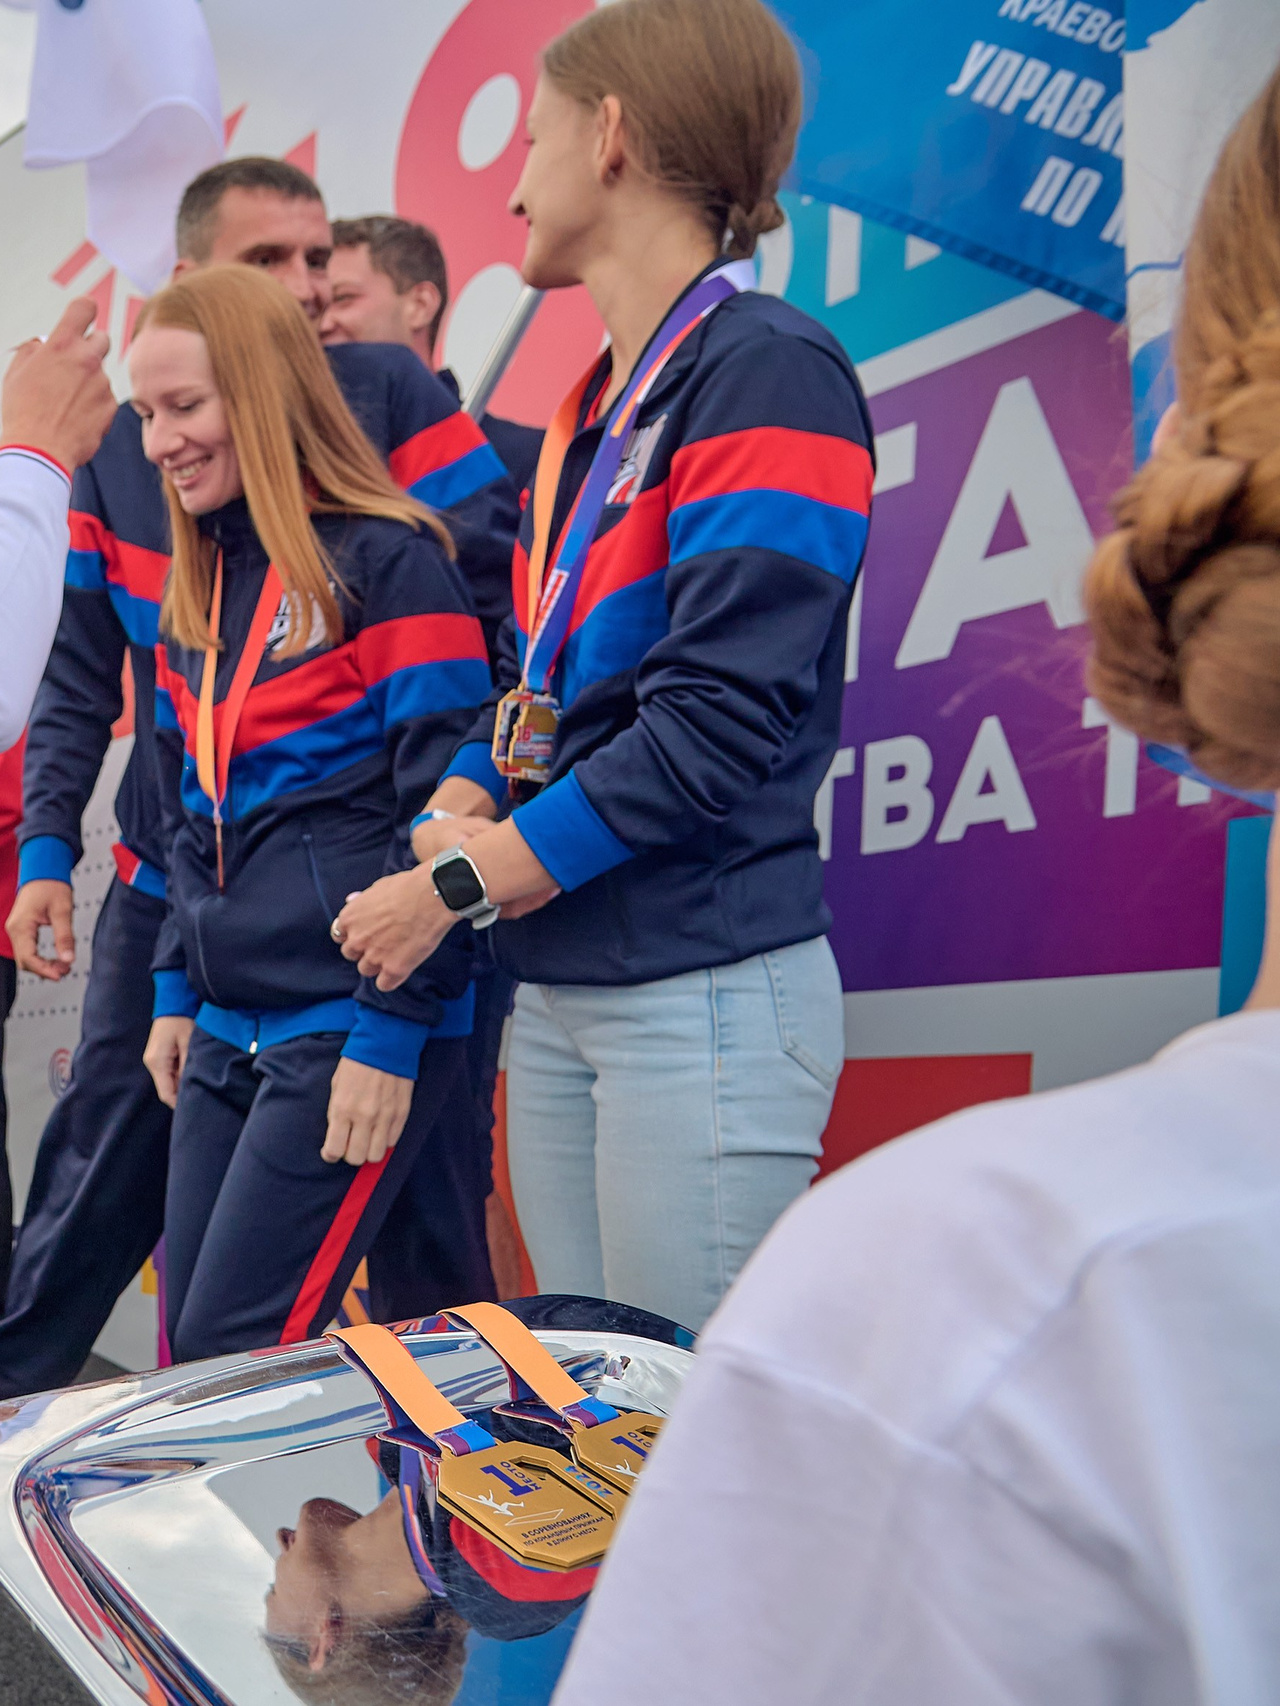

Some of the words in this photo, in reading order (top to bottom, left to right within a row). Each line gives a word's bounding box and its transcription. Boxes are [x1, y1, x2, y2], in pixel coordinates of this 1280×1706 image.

[998, 0, 1126, 57] КРАЕВО
[946, 40, 1124, 160] УПРАВЛ
[1021, 155, 1104, 228] ПО
[627, 1431, 653, 1448] СТО
[479, 1464, 534, 1497] 1
[499, 1461, 542, 1491] МЕСТО
[563, 1465, 614, 1498] 2024
[527, 1512, 593, 1537] СОРЕВНОВАНИЯХ
